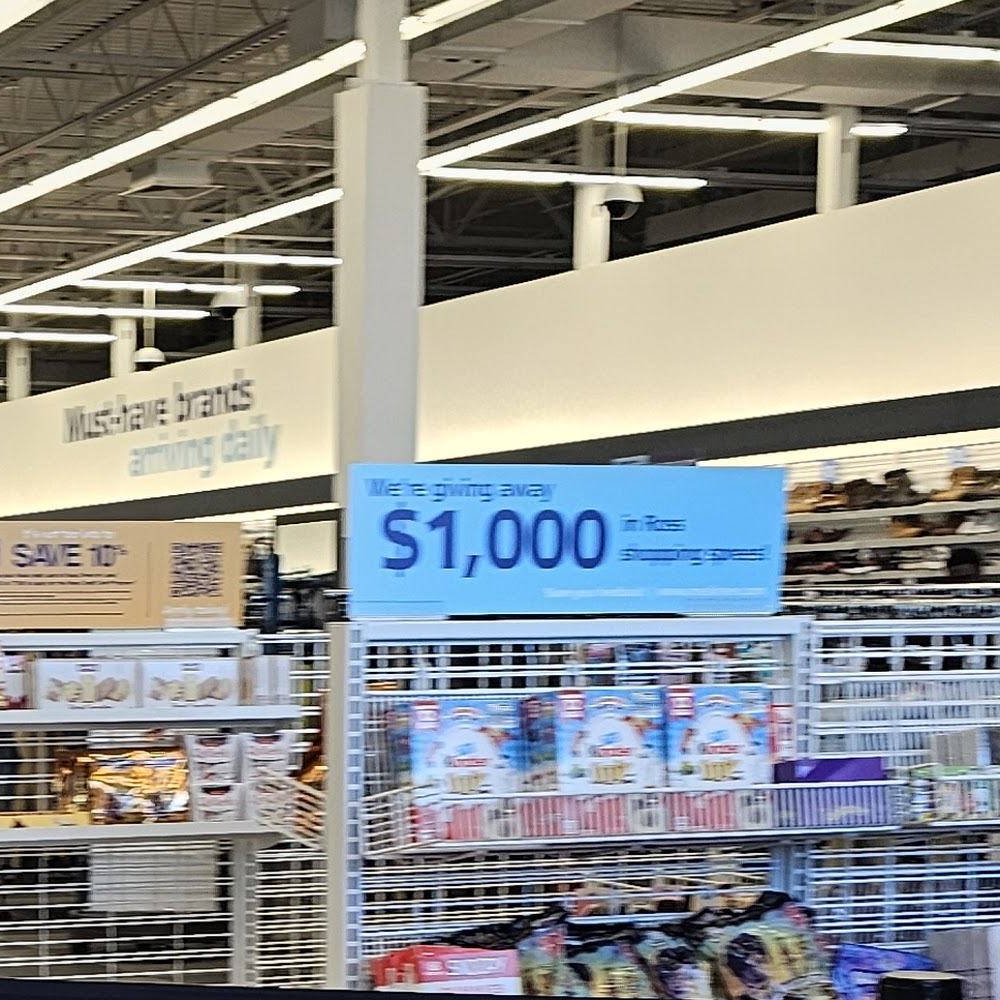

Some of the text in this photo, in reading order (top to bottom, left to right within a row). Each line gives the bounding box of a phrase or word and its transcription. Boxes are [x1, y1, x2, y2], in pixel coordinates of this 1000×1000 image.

[63, 369, 257, 443] Must-have brands
[129, 414, 281, 478] arriving daily
[497, 484, 556, 502] away
[11, 543, 82, 568] SAVE
[381, 505, 609, 578] $1,000
